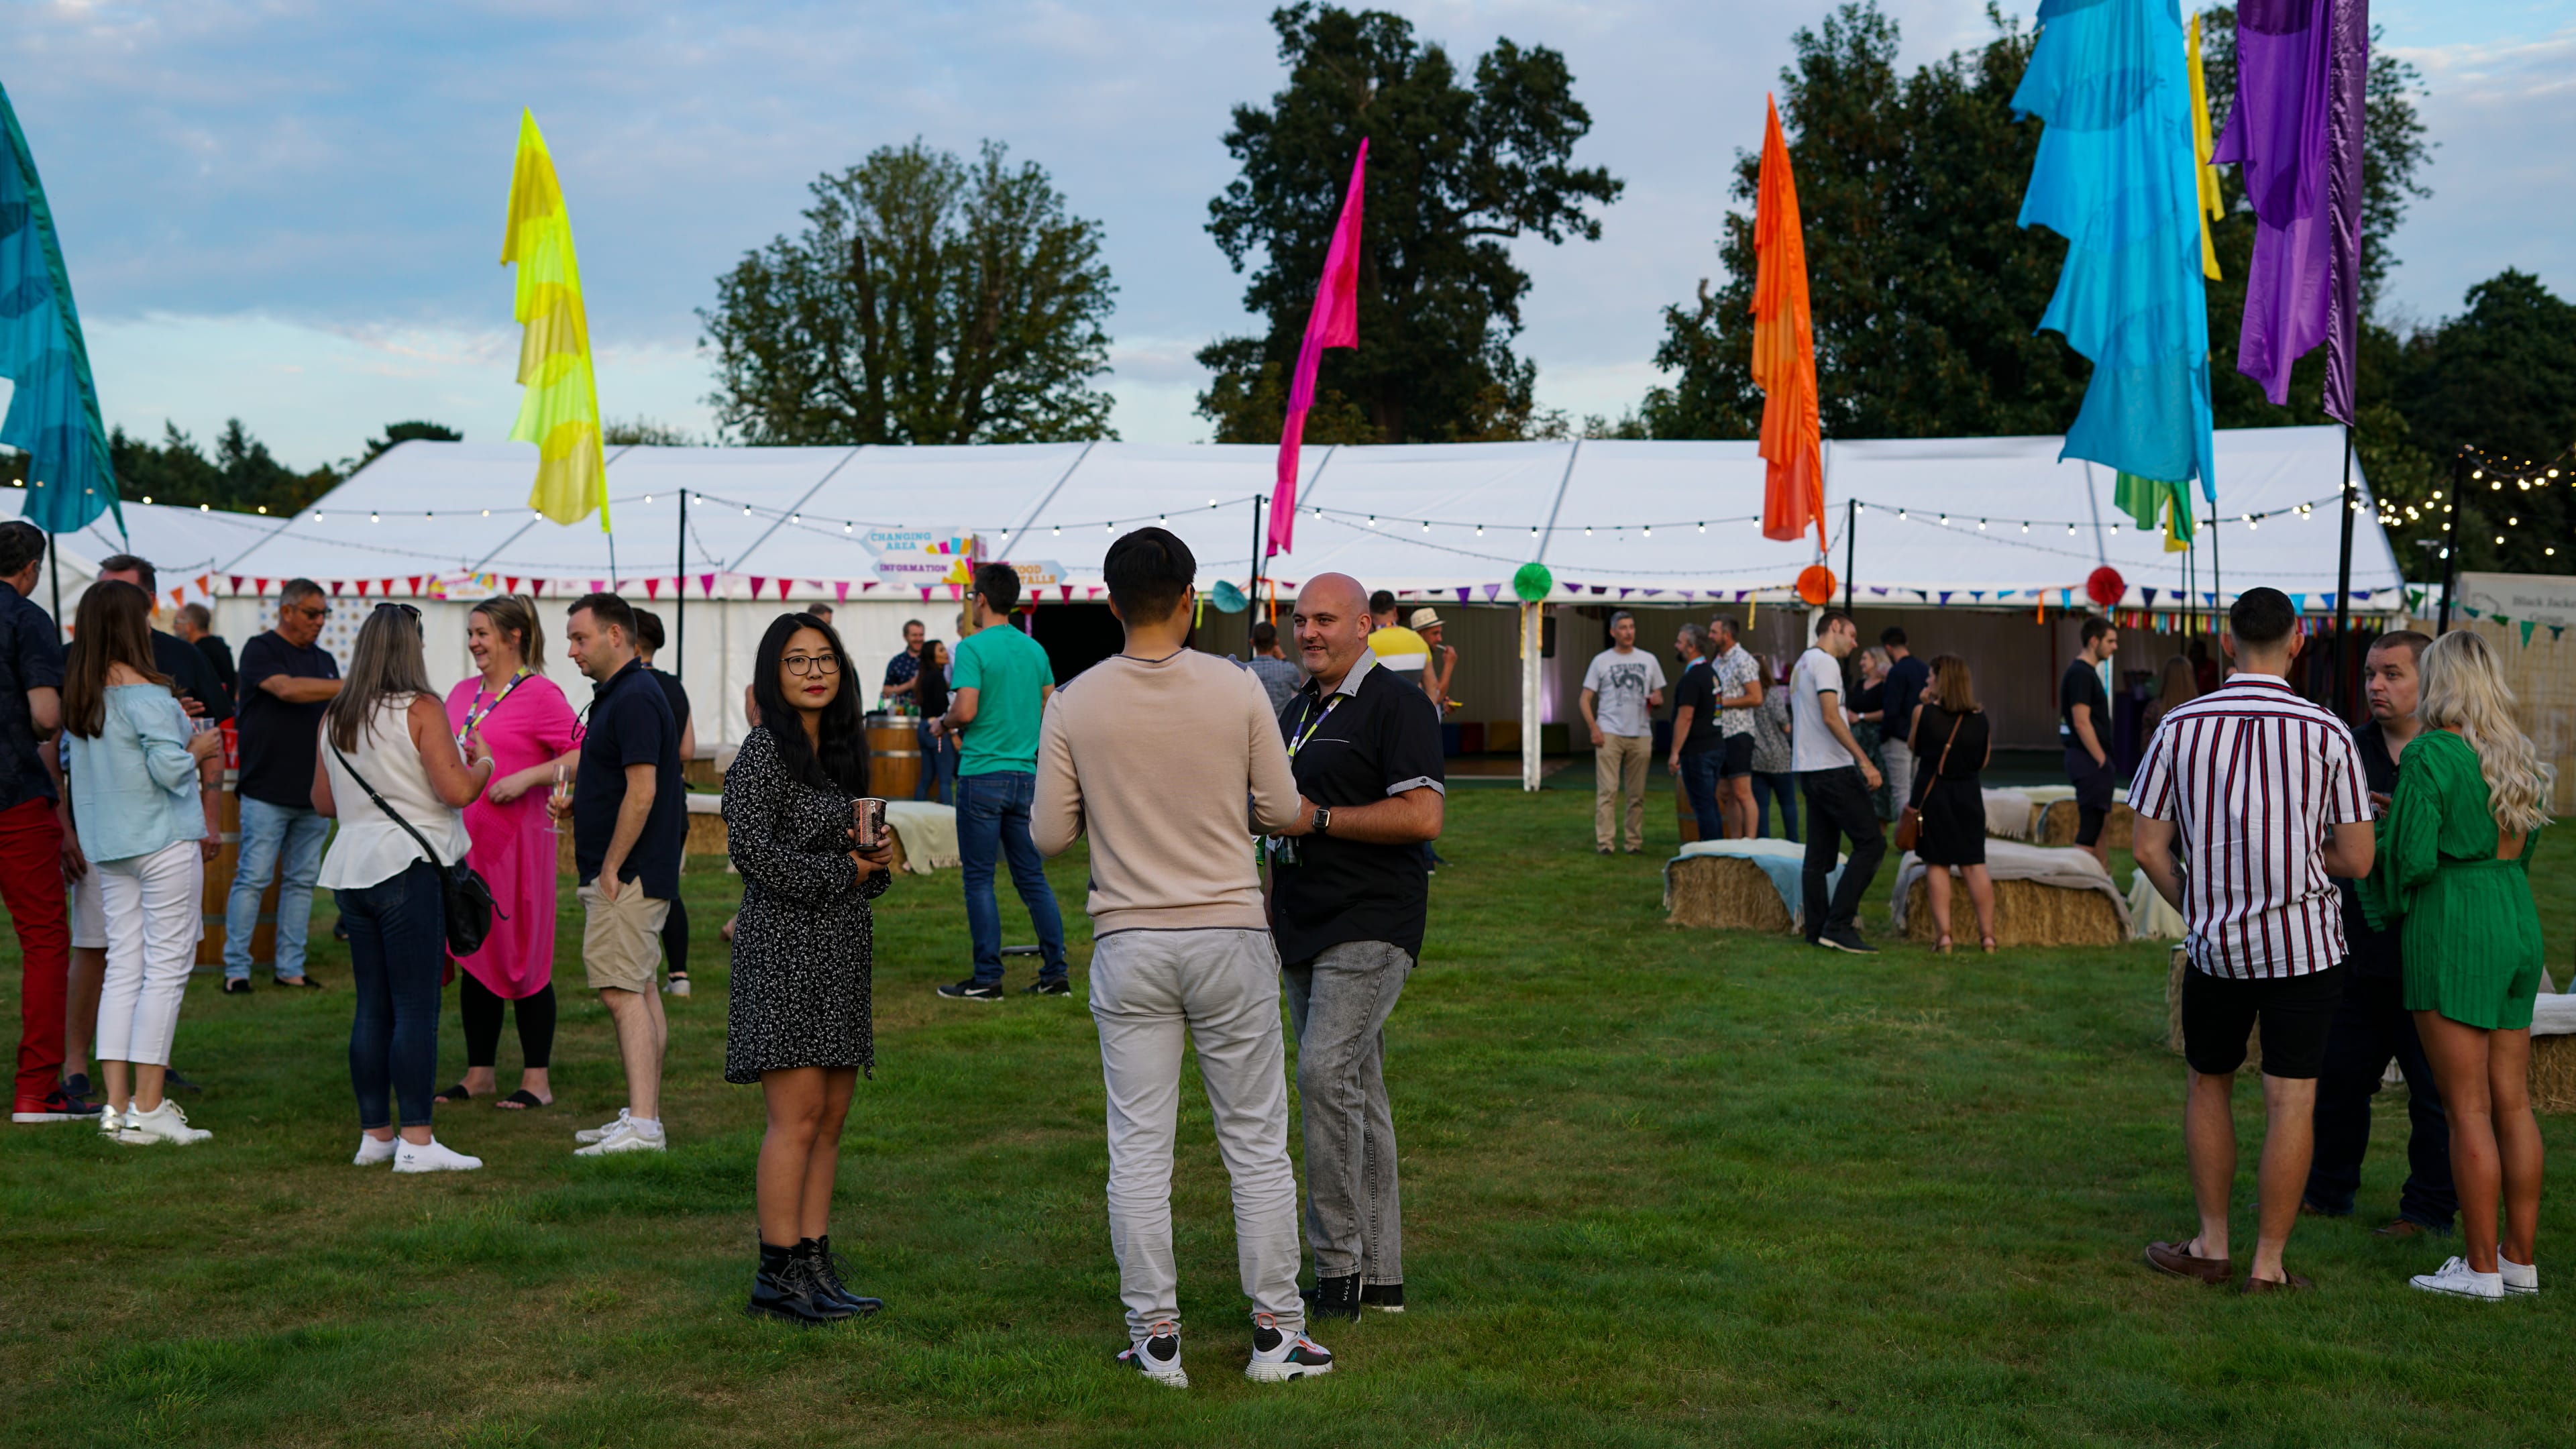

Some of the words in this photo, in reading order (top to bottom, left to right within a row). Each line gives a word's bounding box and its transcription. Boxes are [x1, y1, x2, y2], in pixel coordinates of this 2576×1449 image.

[871, 532, 932, 541] CHANGING
[885, 542, 916, 550] AREA
[879, 564, 948, 572] INFORMATION
